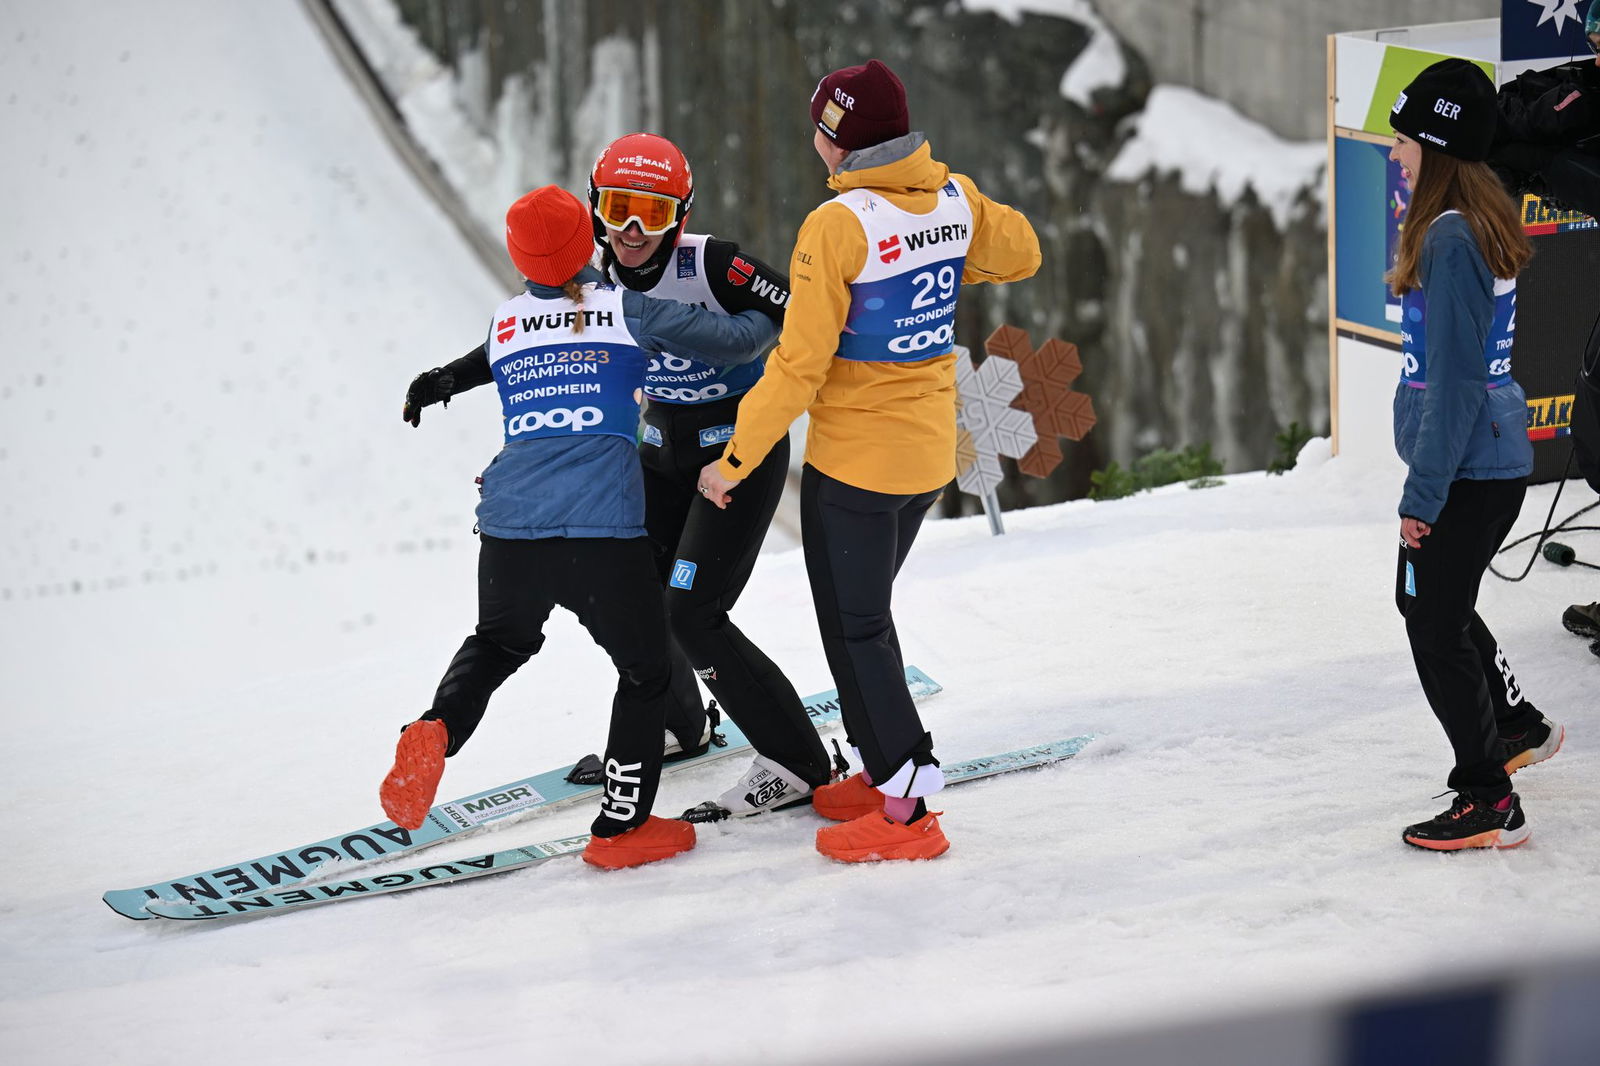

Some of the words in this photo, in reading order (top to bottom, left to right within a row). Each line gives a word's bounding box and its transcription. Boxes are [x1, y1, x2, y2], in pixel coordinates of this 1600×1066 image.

[834, 87, 855, 111] GER
[1433, 98, 1461, 120] GER
[615, 168, 669, 182] Wärmepumpen
[618, 155, 672, 172] VIESSMANN
[911, 265, 955, 310] 29
[500, 353, 556, 376] WORLD
[557, 349, 610, 363] 2023
[507, 363, 598, 386] CHAMPION
[509, 384, 601, 405] TRONDHEIM
[508, 406, 604, 436] coop
[463, 787, 532, 814] MBR
[600, 757, 642, 821] GER
[444, 806, 470, 828] MBR
[474, 797, 541, 820] mbr-cosmetics.com
[193, 853, 495, 917] AUGMENT
